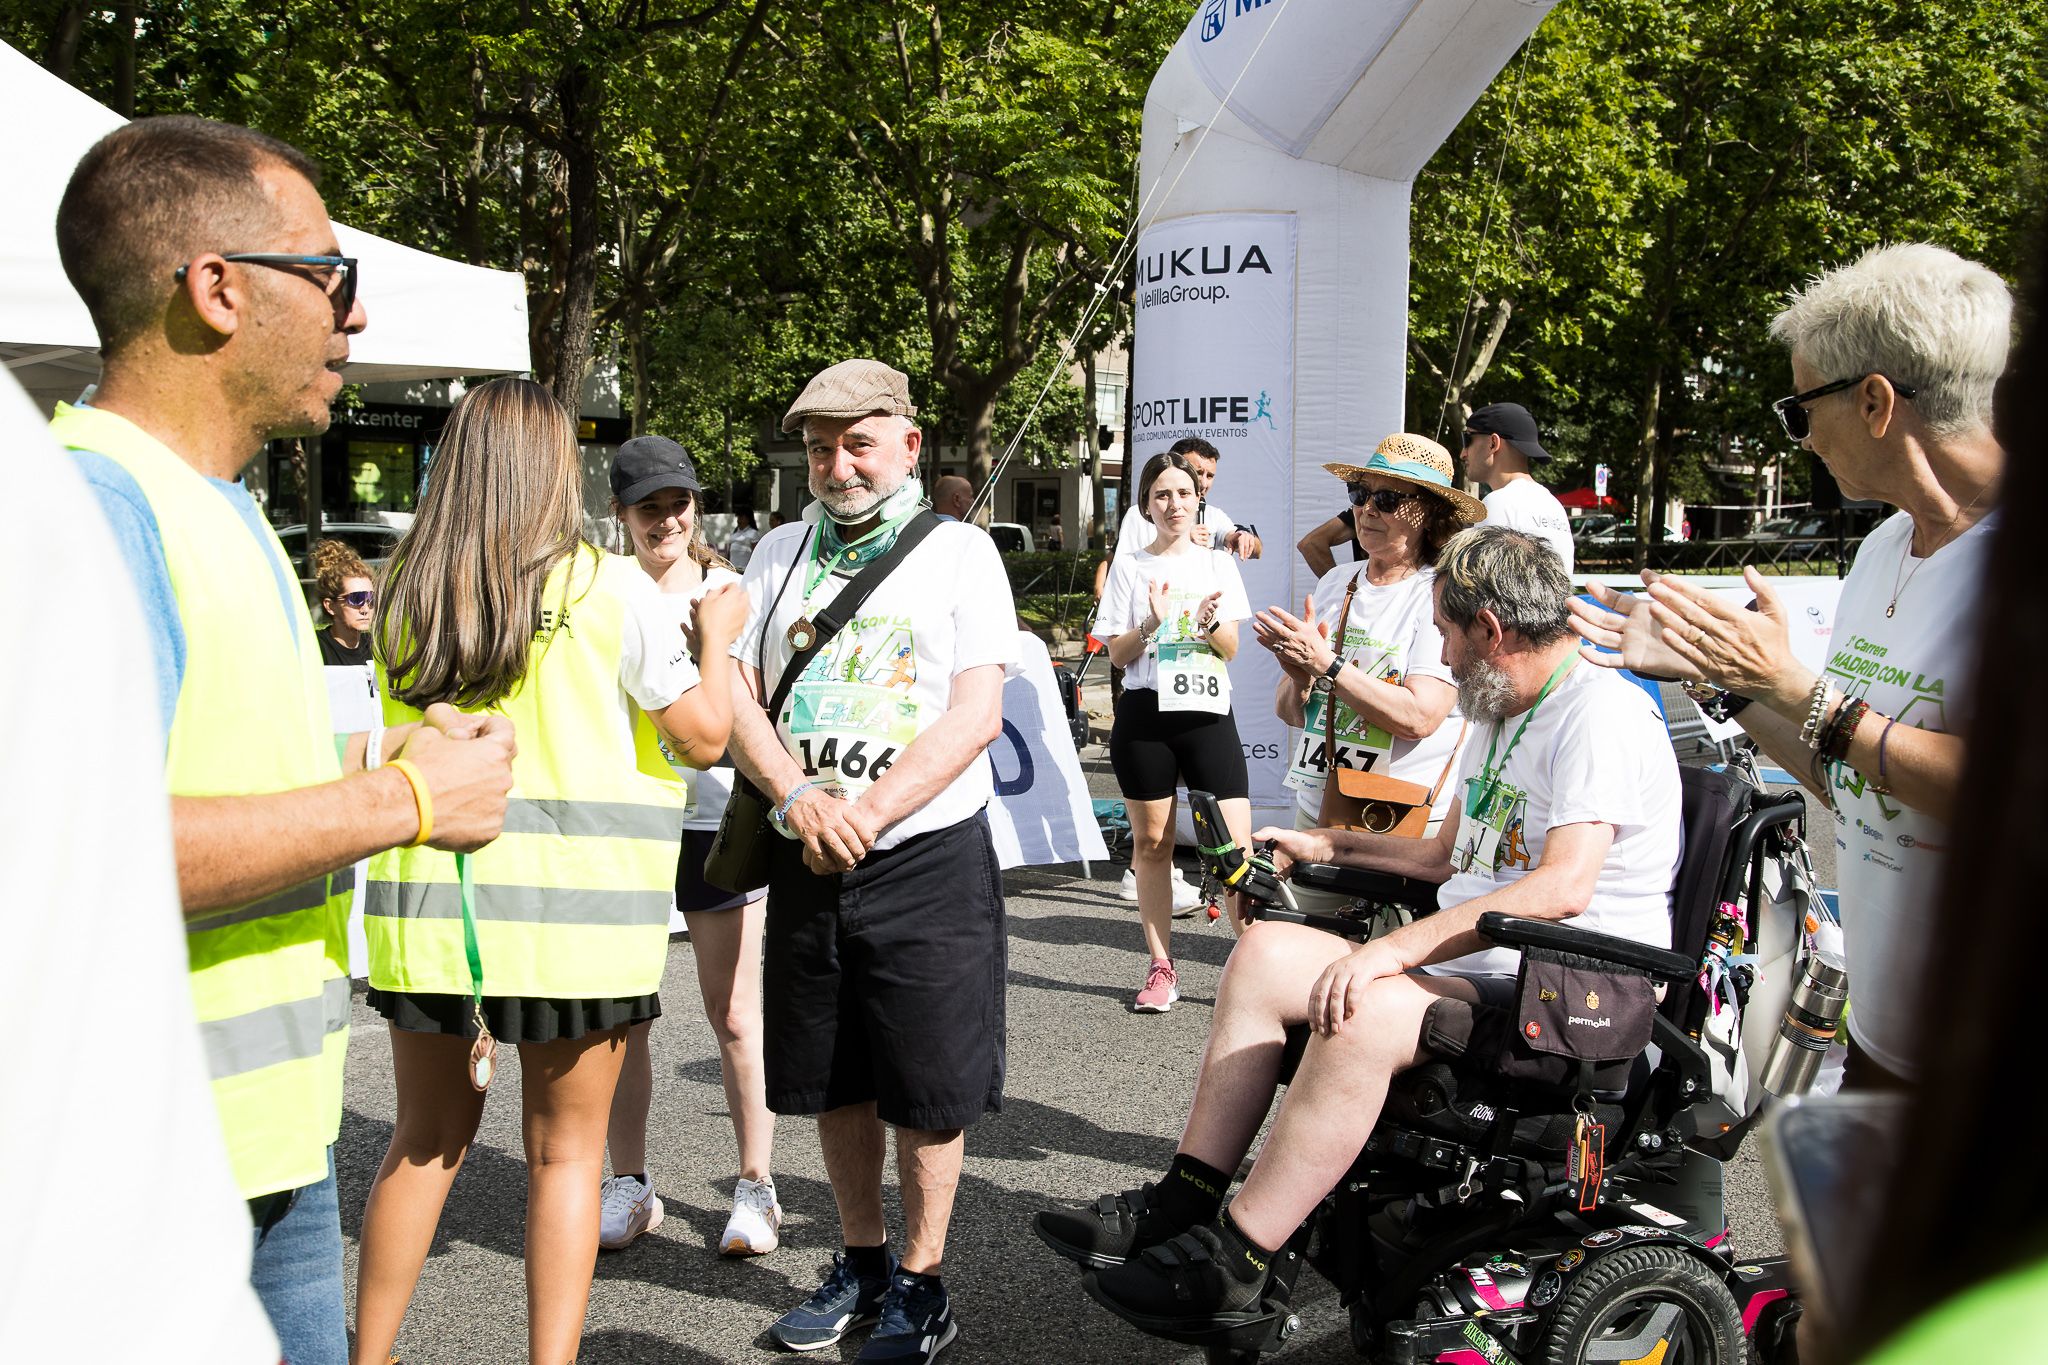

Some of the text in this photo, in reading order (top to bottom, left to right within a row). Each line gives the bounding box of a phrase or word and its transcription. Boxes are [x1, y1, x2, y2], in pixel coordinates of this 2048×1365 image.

[328, 410, 423, 428] orkcenter
[1205, 428, 1248, 438] EVENTOS
[860, 615, 888, 629] CON
[1854, 637, 1888, 658] Carrera
[1173, 673, 1220, 698] 858
[1829, 650, 1944, 697] MADRID CON LA
[812, 695, 893, 734] ELA
[799, 737, 897, 783] 1466
[1298, 737, 1380, 773] 1467
[1568, 1015, 1611, 1029] permobil
[1570, 1146, 1580, 1181] RAQUEL
[1463, 1321, 1490, 1352] BIKERS
